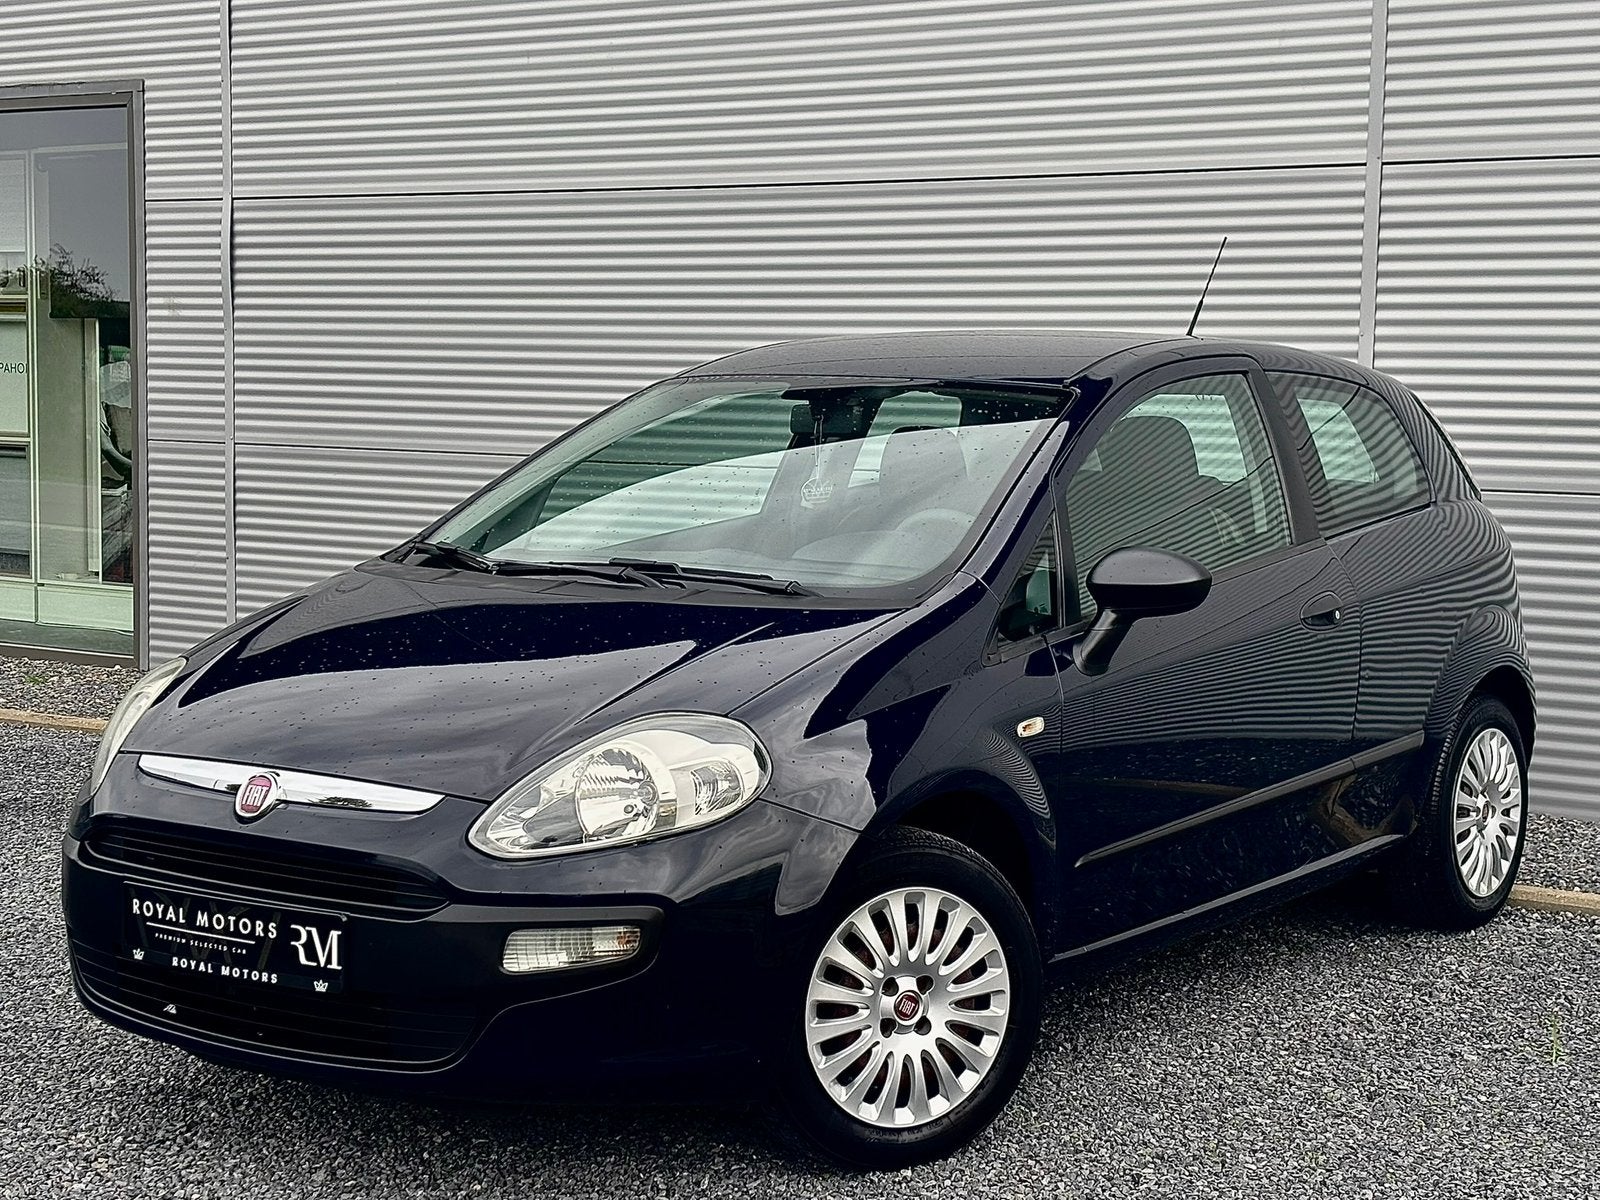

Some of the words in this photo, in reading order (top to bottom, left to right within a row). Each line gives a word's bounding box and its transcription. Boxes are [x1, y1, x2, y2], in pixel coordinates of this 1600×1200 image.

[241, 783, 271, 807] FIAT
[132, 898, 186, 923] ROYAL
[196, 910, 277, 939] MOTORS
[154, 932, 186, 943] PREMIUM
[189, 939, 228, 952] SELECTED
[290, 924, 342, 970] RM
[172, 956, 213, 974] ROYAL
[221, 965, 278, 984] MOTORS
[898, 998, 916, 1016] FIAT
